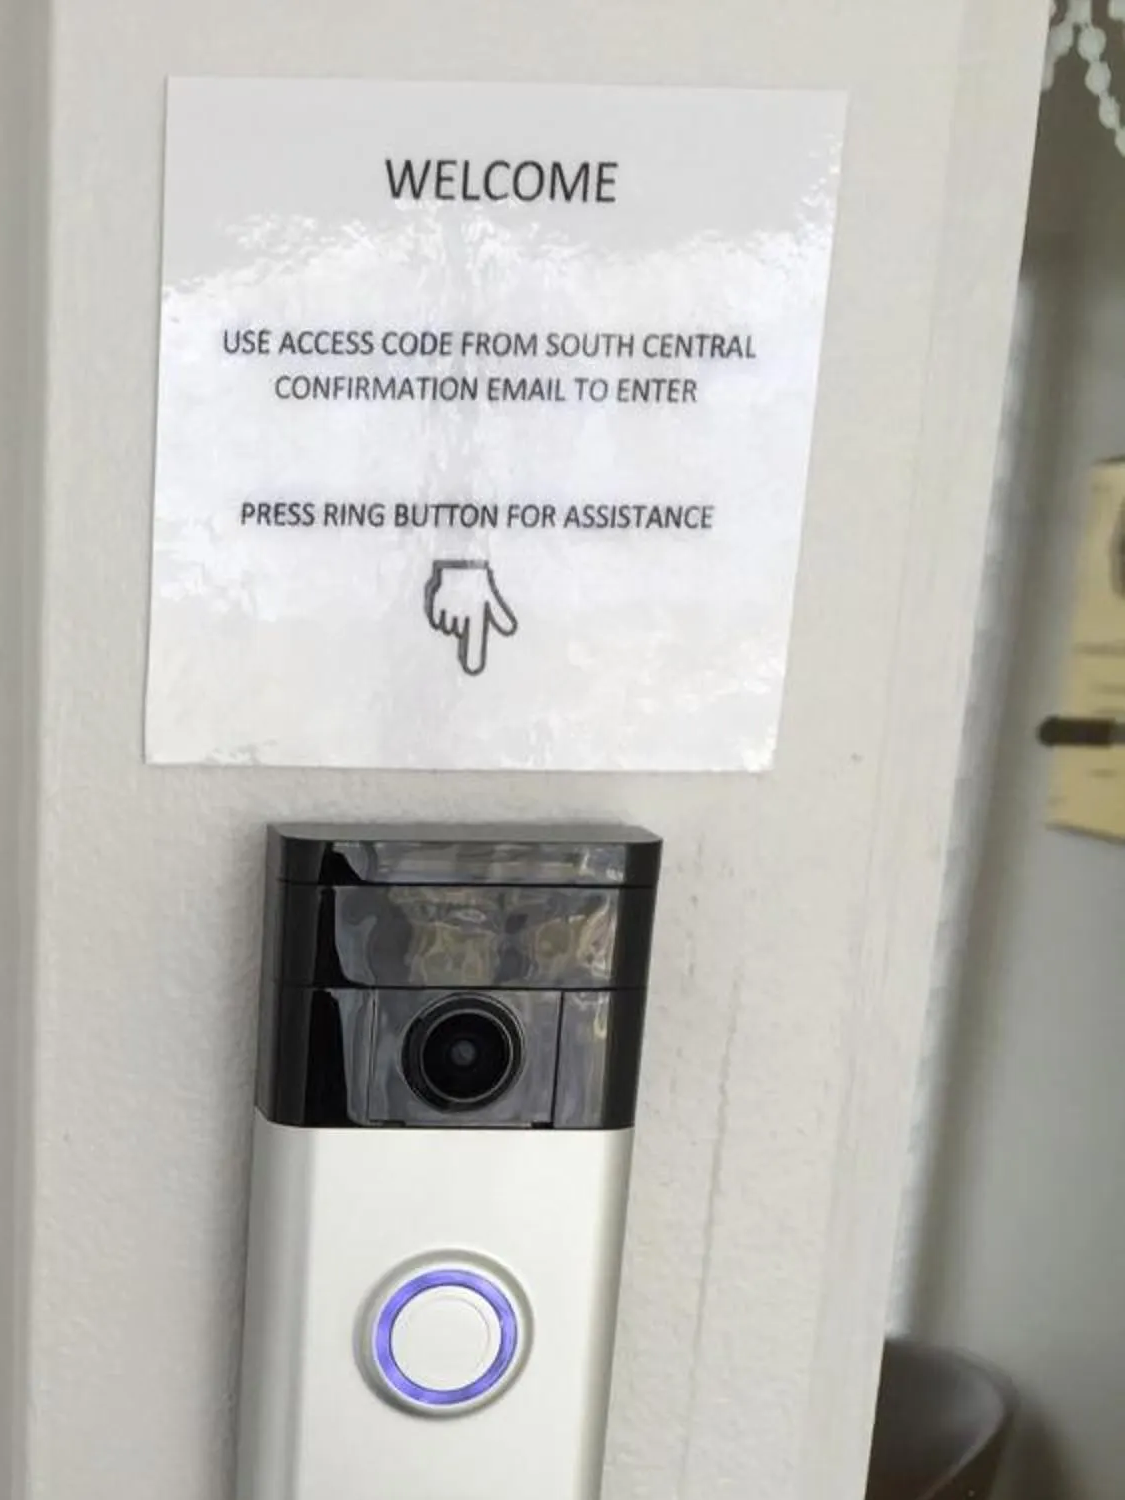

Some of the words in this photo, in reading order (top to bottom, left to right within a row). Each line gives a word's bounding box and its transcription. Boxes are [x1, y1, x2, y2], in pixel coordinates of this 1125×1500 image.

[383, 157, 621, 205] WELCOME
[221, 327, 273, 357] USE
[276, 329, 376, 357] ACCESS
[380, 329, 455, 359] CODE
[459, 329, 539, 359] FROM
[544, 331, 636, 359] SOUTH
[641, 331, 758, 361] CENTRAL
[273, 373, 480, 403] CONFIRMATION
[485, 376, 567, 404] EMAIL
[573, 376, 610, 404] TO
[615, 376, 699, 405] ENTER
[238, 500, 317, 529] PRESS
[321, 500, 387, 530] RING
[392, 501, 500, 530] BUTTON
[505, 502, 558, 530] FOR
[561, 502, 716, 531] ASSISTANCE
